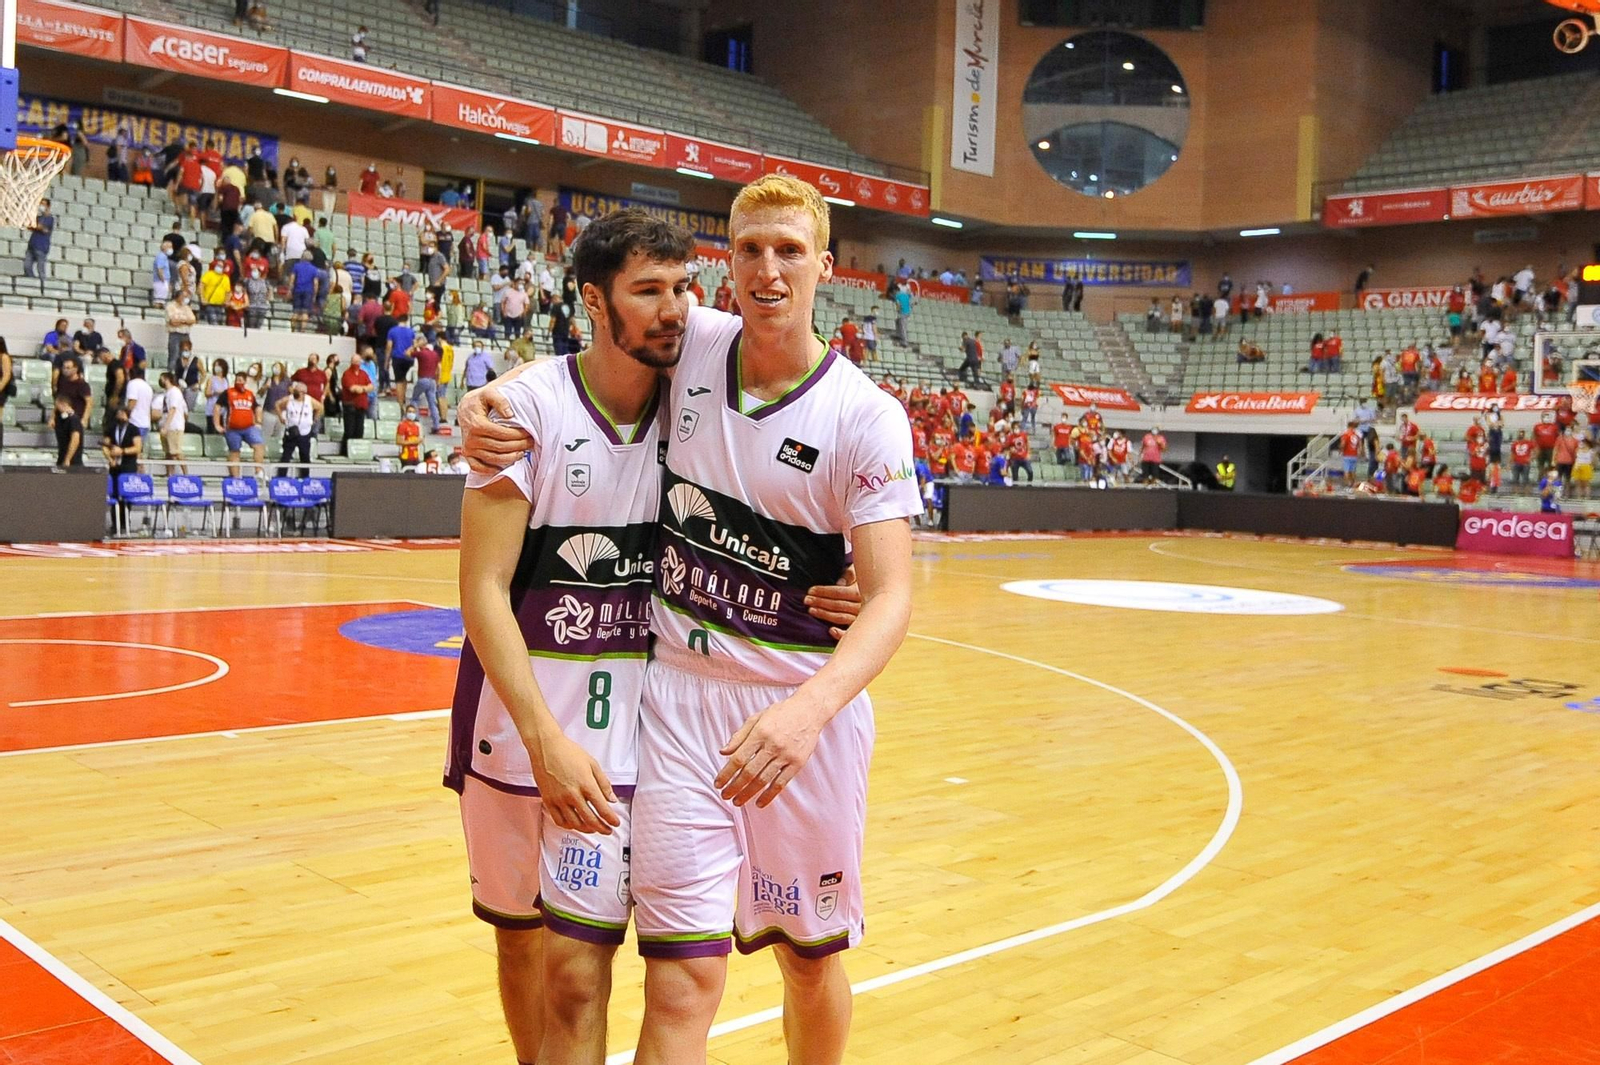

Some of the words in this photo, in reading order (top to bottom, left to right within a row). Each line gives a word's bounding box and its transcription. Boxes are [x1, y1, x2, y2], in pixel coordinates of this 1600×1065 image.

[165, 37, 229, 66] caser
[227, 57, 269, 73] seguros
[297, 67, 407, 101] COMPRALAENTRADA
[994, 260, 1046, 279] UCAM
[1052, 261, 1179, 283] UNIVERSIDAD
[1220, 394, 1307, 410] CaixaBank
[1464, 515, 1569, 541] endesa
[709, 523, 791, 571] Unicaja
[690, 566, 782, 611] MÁLAGA
[689, 589, 718, 611] Deporte
[726, 607, 733, 620] y
[742, 609, 778, 627] Eventos
[629, 626, 636, 639] y
[585, 670, 612, 730] 8
[821, 878, 838, 886] acb
